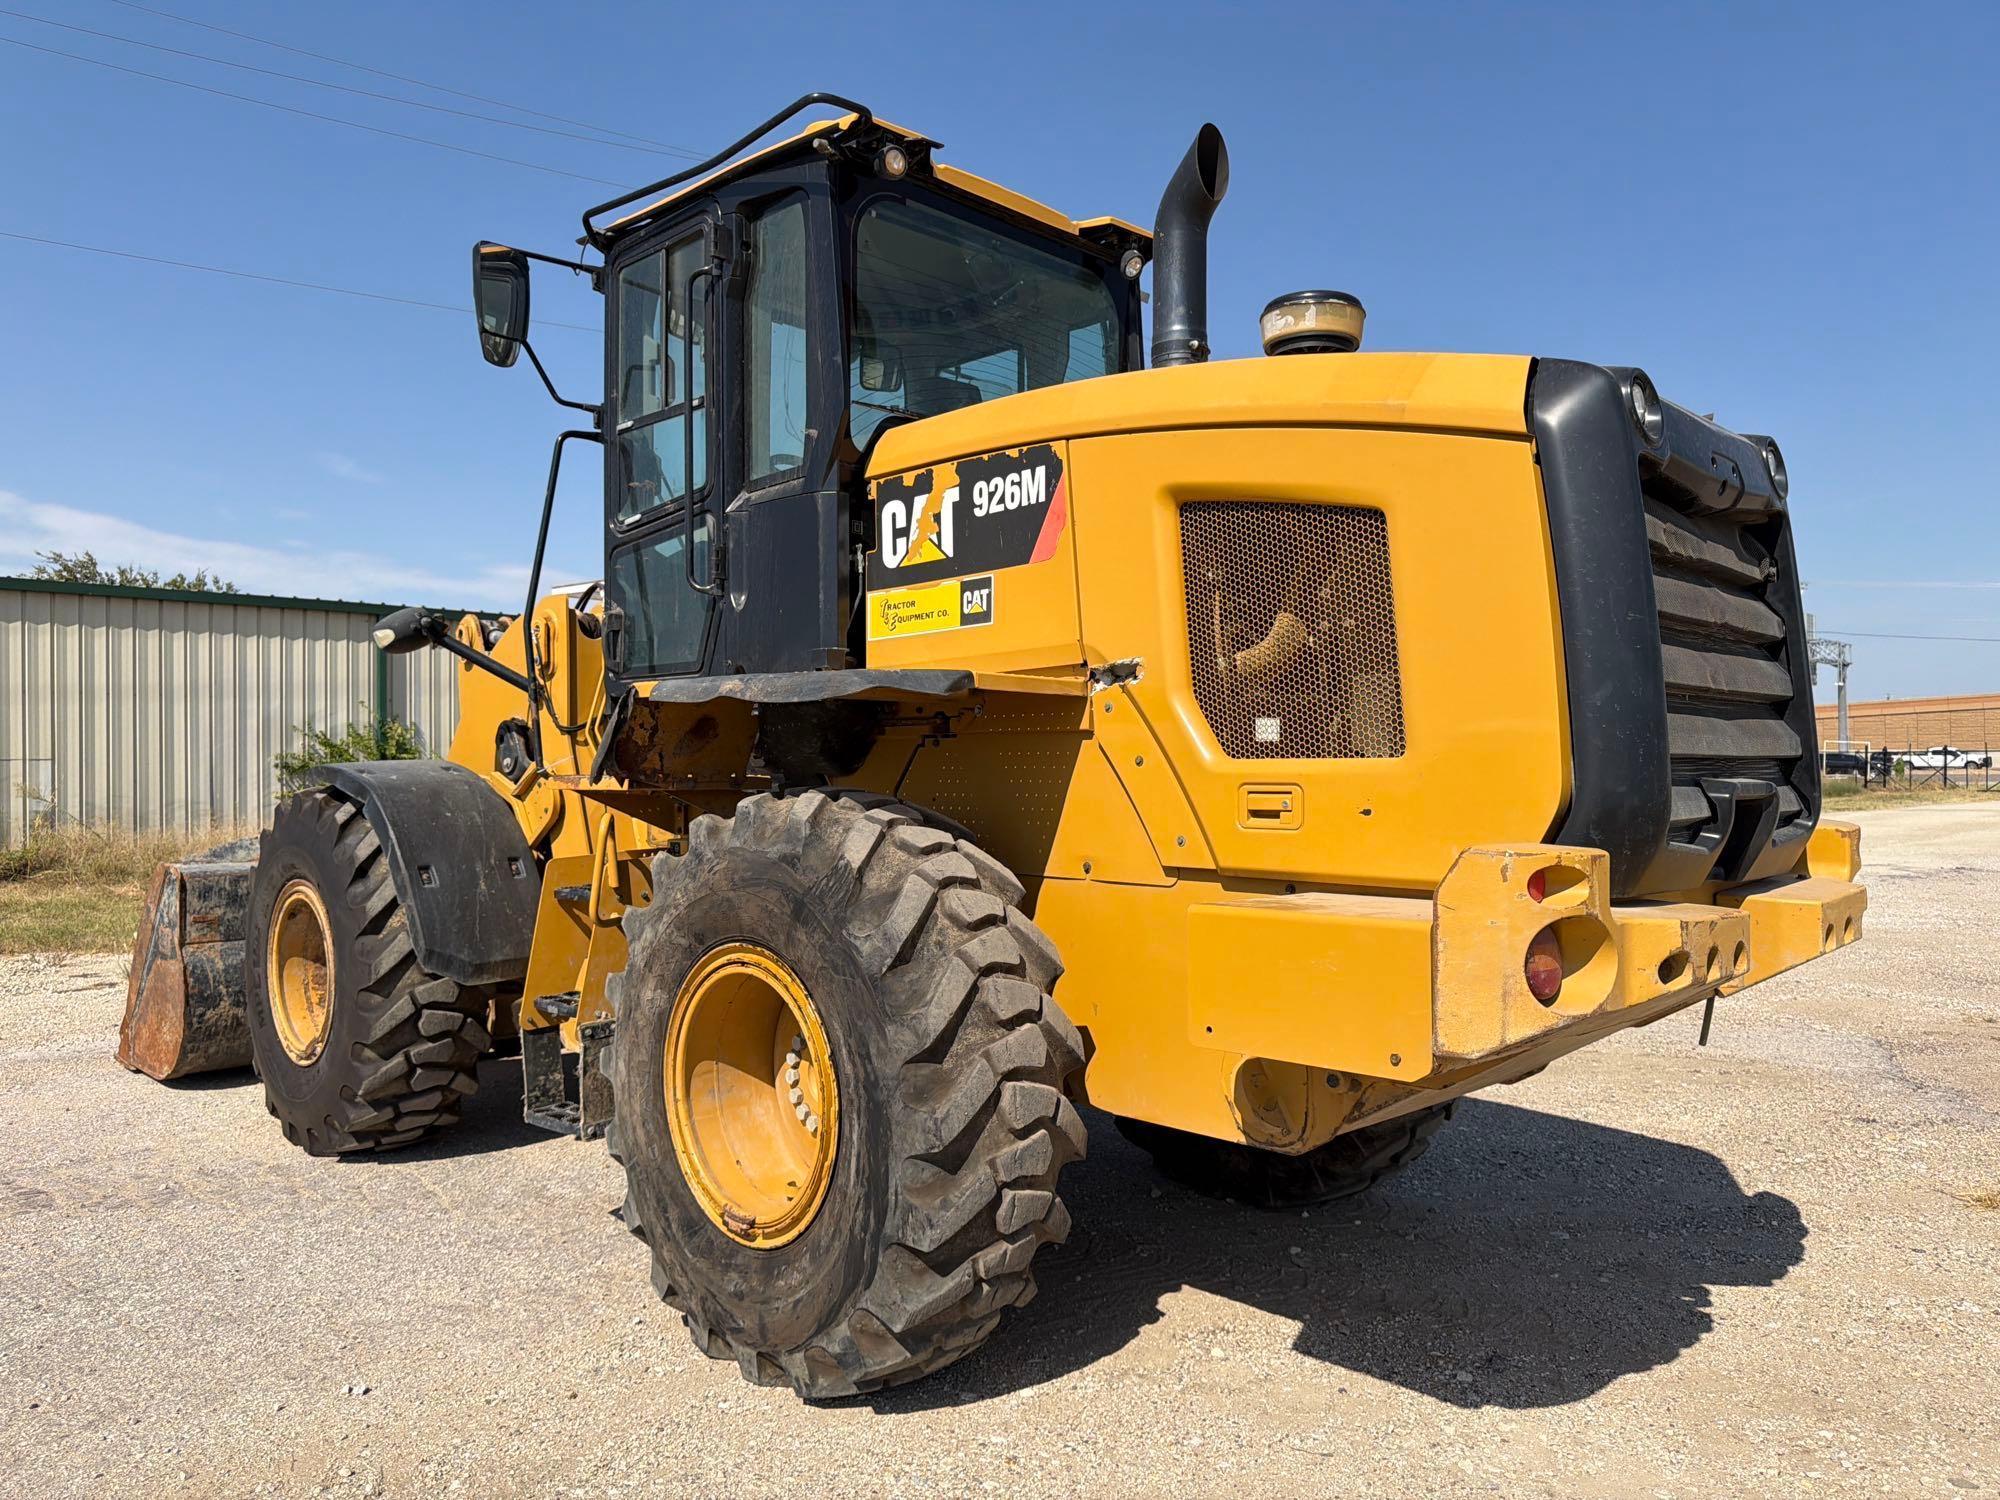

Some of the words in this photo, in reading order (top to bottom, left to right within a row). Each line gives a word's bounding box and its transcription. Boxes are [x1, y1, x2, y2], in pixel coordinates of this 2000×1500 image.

[973, 465, 1046, 517] 926M
[880, 599, 916, 618] TRACTOR
[963, 588, 990, 615] CAT
[889, 612, 935, 632] EQUIPMENT
[937, 609, 950, 618] CO.
